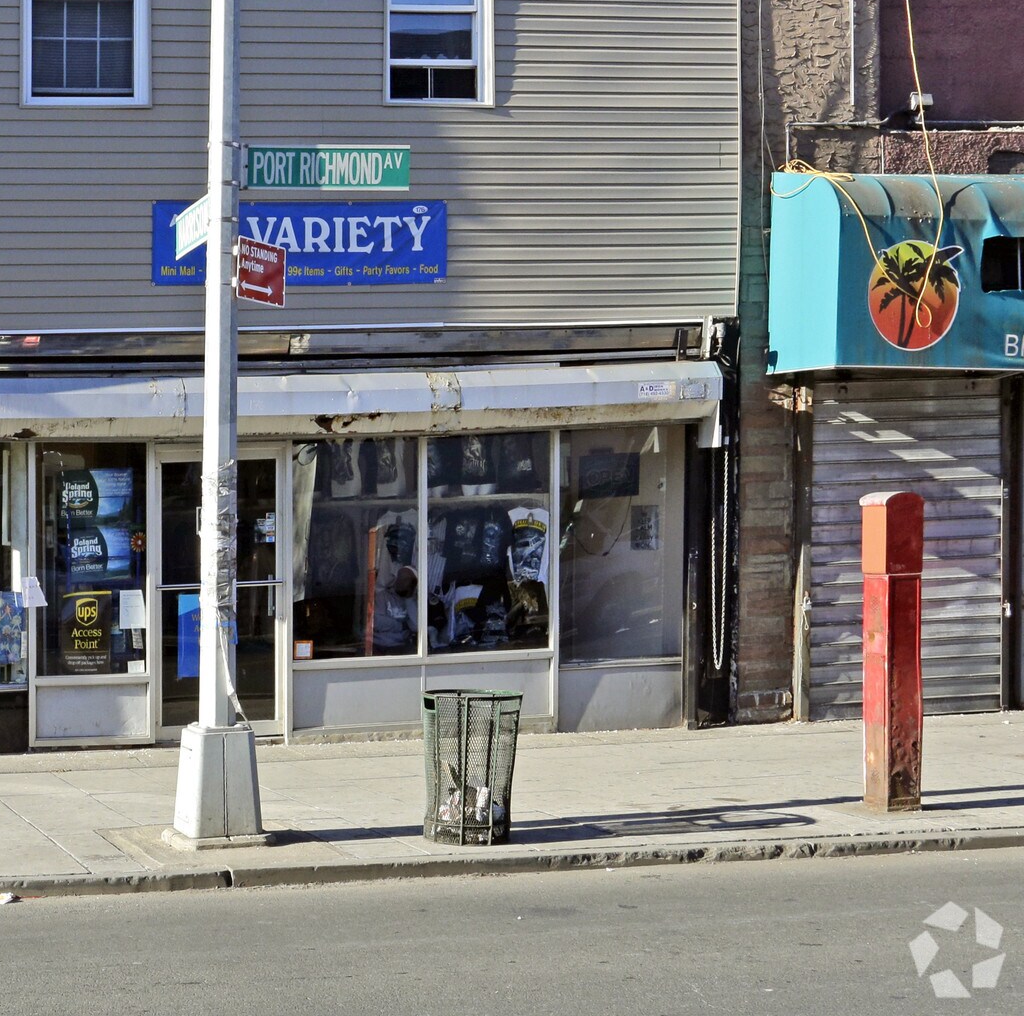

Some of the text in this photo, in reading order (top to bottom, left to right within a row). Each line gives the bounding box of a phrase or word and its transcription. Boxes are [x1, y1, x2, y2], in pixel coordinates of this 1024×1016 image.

[253, 151, 404, 185] PORT RICHMOND AV
[246, 215, 432, 255] VARIETY
[241, 243, 278, 263] NO STANDING
[160, 266, 177, 276] Mini
[179, 265, 196, 276] Mall
[304, 266, 325, 276] Items
[334, 265, 353, 276] Gifts
[362, 265, 383, 277] Party
[385, 264, 410, 275] Favors
[419, 264, 439, 274] Food
[241, 257, 264, 274] Anytime
[62, 489, 93, 503] Spring
[73, 537, 98, 547] Poland
[71, 544, 103, 559] Spring
[78, 606, 96, 622] ups
[71, 628, 102, 638] Access
[74, 639, 98, 650] Point
